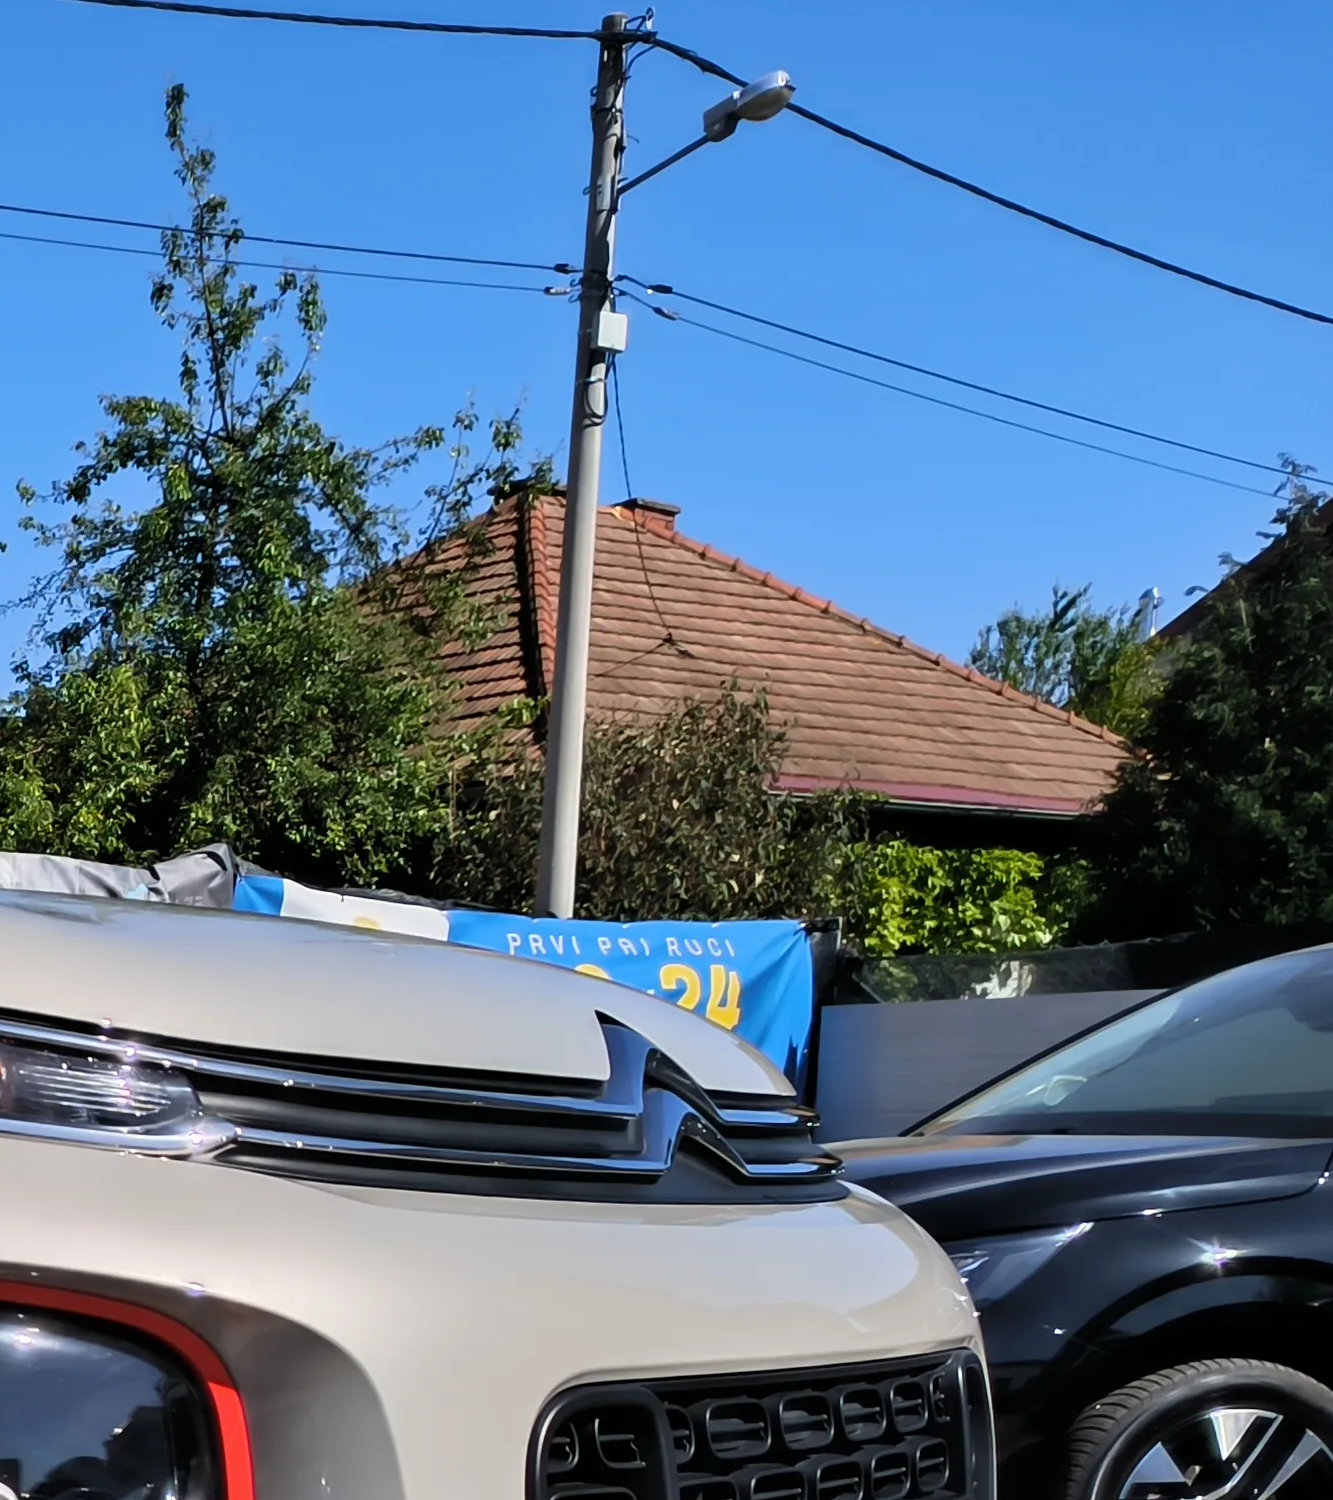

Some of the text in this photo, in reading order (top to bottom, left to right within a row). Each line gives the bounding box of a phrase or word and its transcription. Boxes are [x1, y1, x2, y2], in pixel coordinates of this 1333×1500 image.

[506, 933, 735, 957] PRVI PRI RUCI
